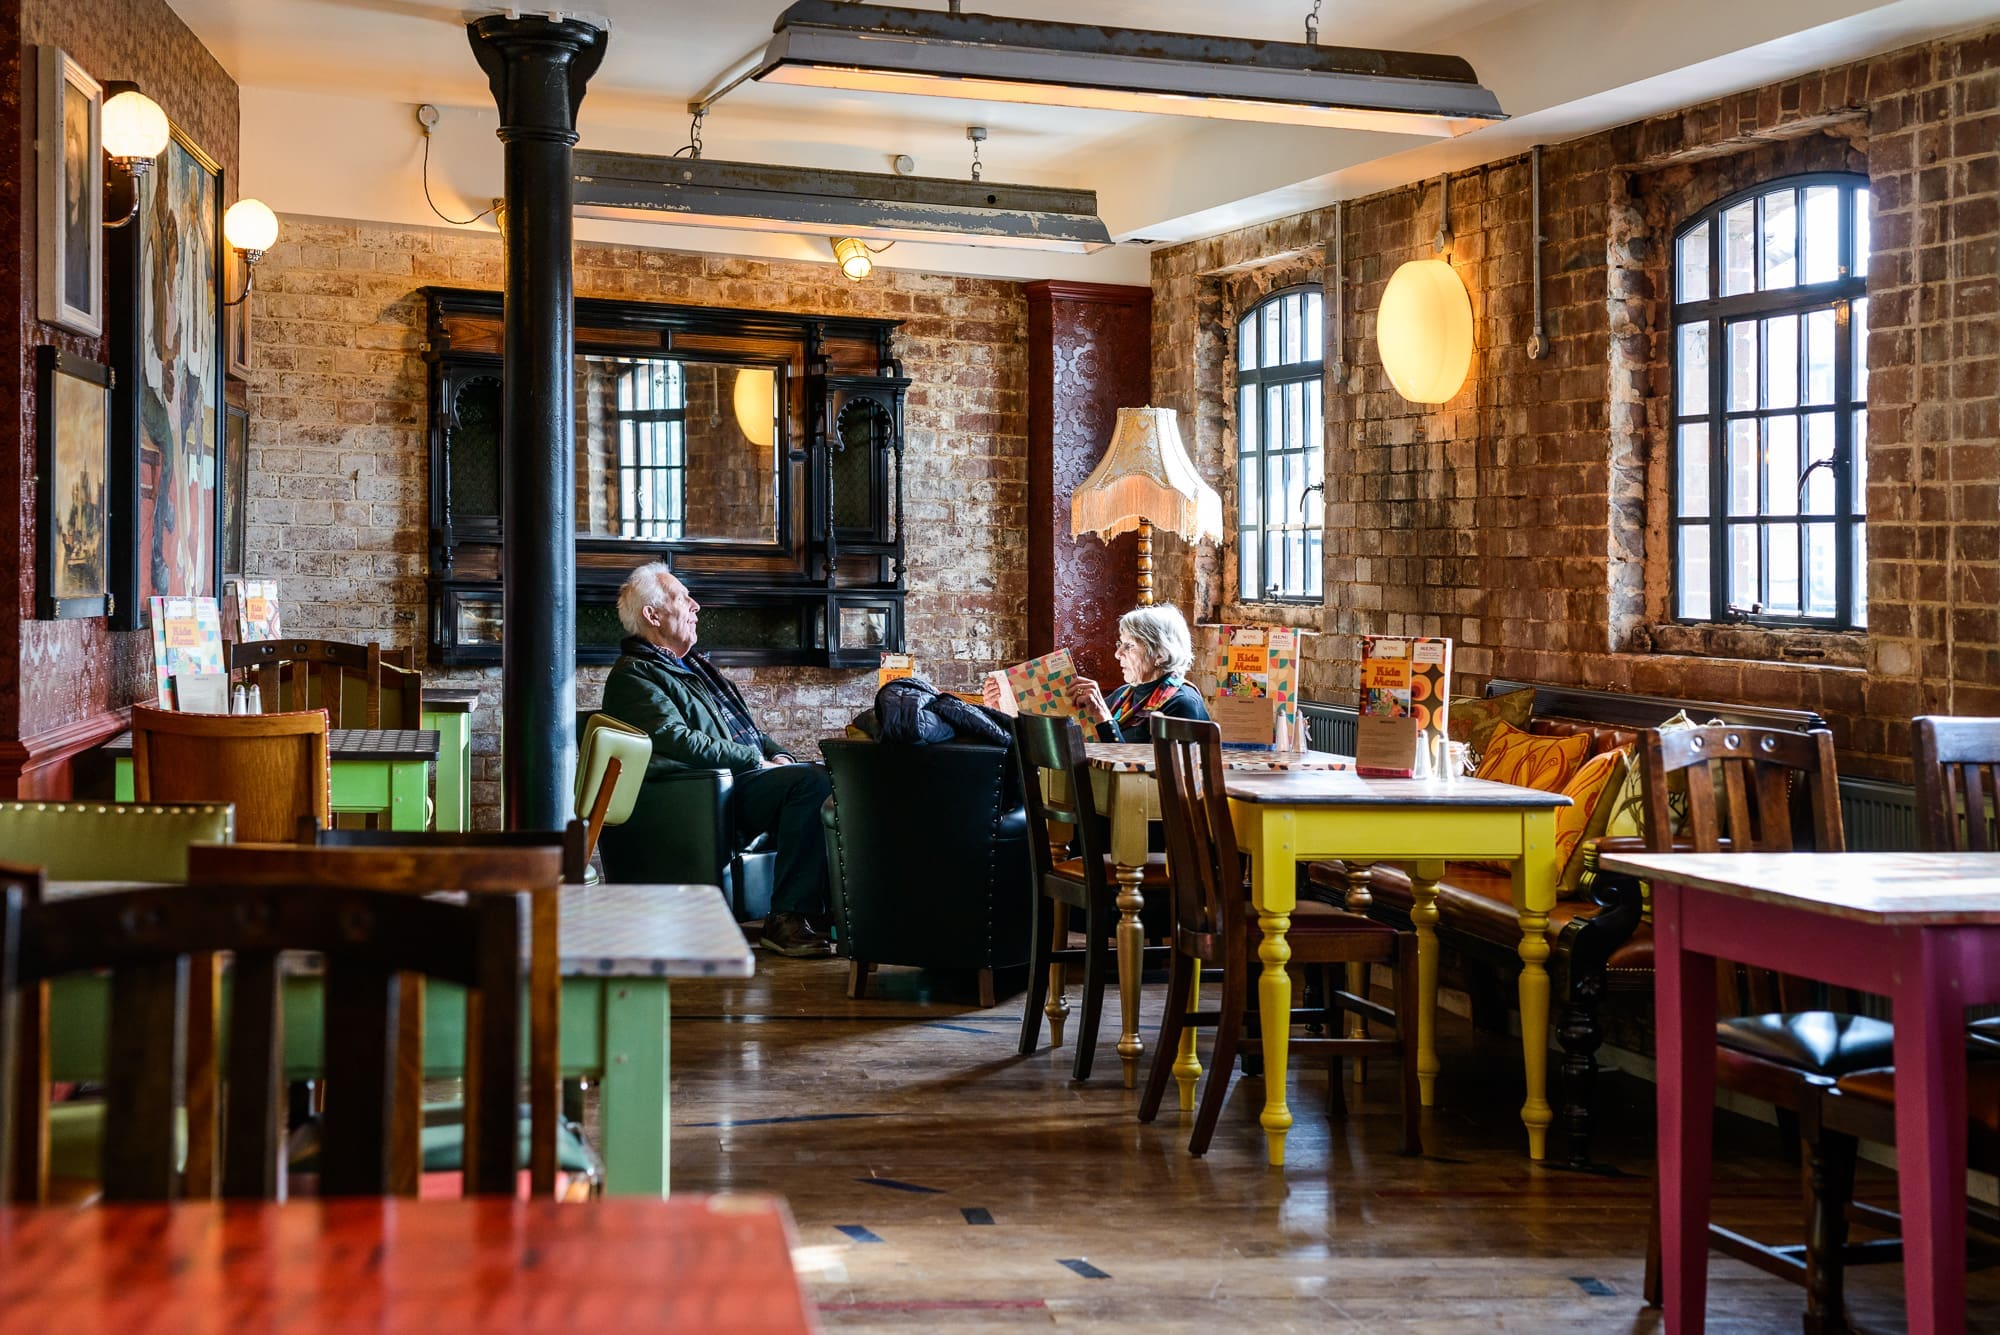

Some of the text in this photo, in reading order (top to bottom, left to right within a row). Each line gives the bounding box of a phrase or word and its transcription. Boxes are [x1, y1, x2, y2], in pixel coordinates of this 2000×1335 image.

[1237, 652, 1260, 663] Kids
[1233, 661, 1262, 672] Menu
[1376, 666, 1401, 677] Kids
[1372, 676, 1404, 687] Menu
